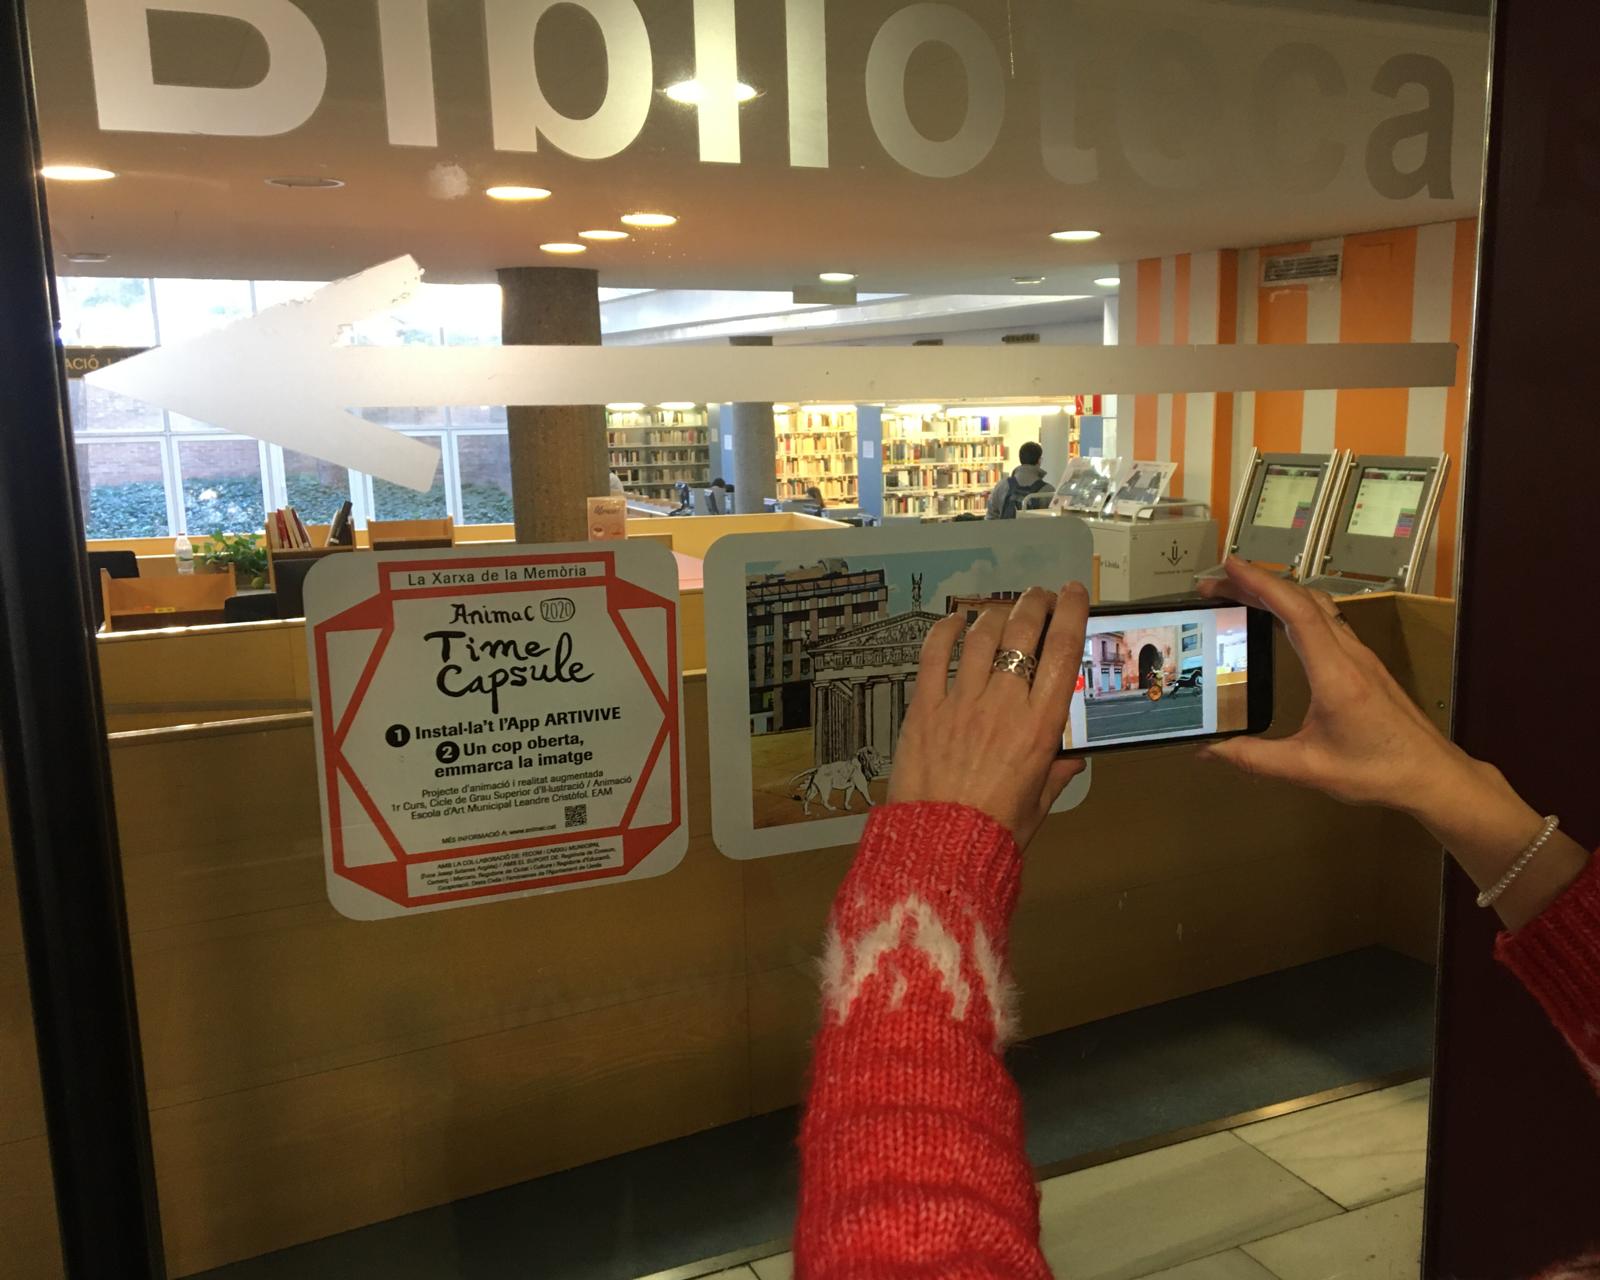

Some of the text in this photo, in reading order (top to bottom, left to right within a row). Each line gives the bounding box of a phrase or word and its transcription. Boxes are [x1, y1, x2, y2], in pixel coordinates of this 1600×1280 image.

[86, 0, 1455, 200] Biblioteca
[408, 565, 587, 586] La Xarxa de la Memòria
[543, 601, 572, 620] 2020
[423, 631, 551, 663] Time
[436, 632, 595, 715] Capsule
[544, 706, 621, 727] ARTIVIVE
[463, 742, 487, 757] Un
[492, 740, 522, 755] cop
[527, 733, 584, 750] oberta,
[434, 749, 593, 778] emmarca la imatge
[392, 803, 401, 812] 1r
[429, 798, 453, 807] Cicle
[455, 796, 467, 804] de
[469, 793, 491, 802] Grau
[493, 787, 530, 800] Superior
[593, 776, 632, 788] Animació
[422, 788, 459, 798] Projecte
[461, 780, 510, 793] d'animació
[518, 776, 548, 786] realitat
[550, 769, 604, 783] augmentada
[411, 810, 441, 820] Escola
[467, 799, 512, 814] Municipal
[514, 797, 550, 808] Leandre
[592, 787, 613, 798] EAM
[457, 830, 501, 841] INFORMACIÓ
